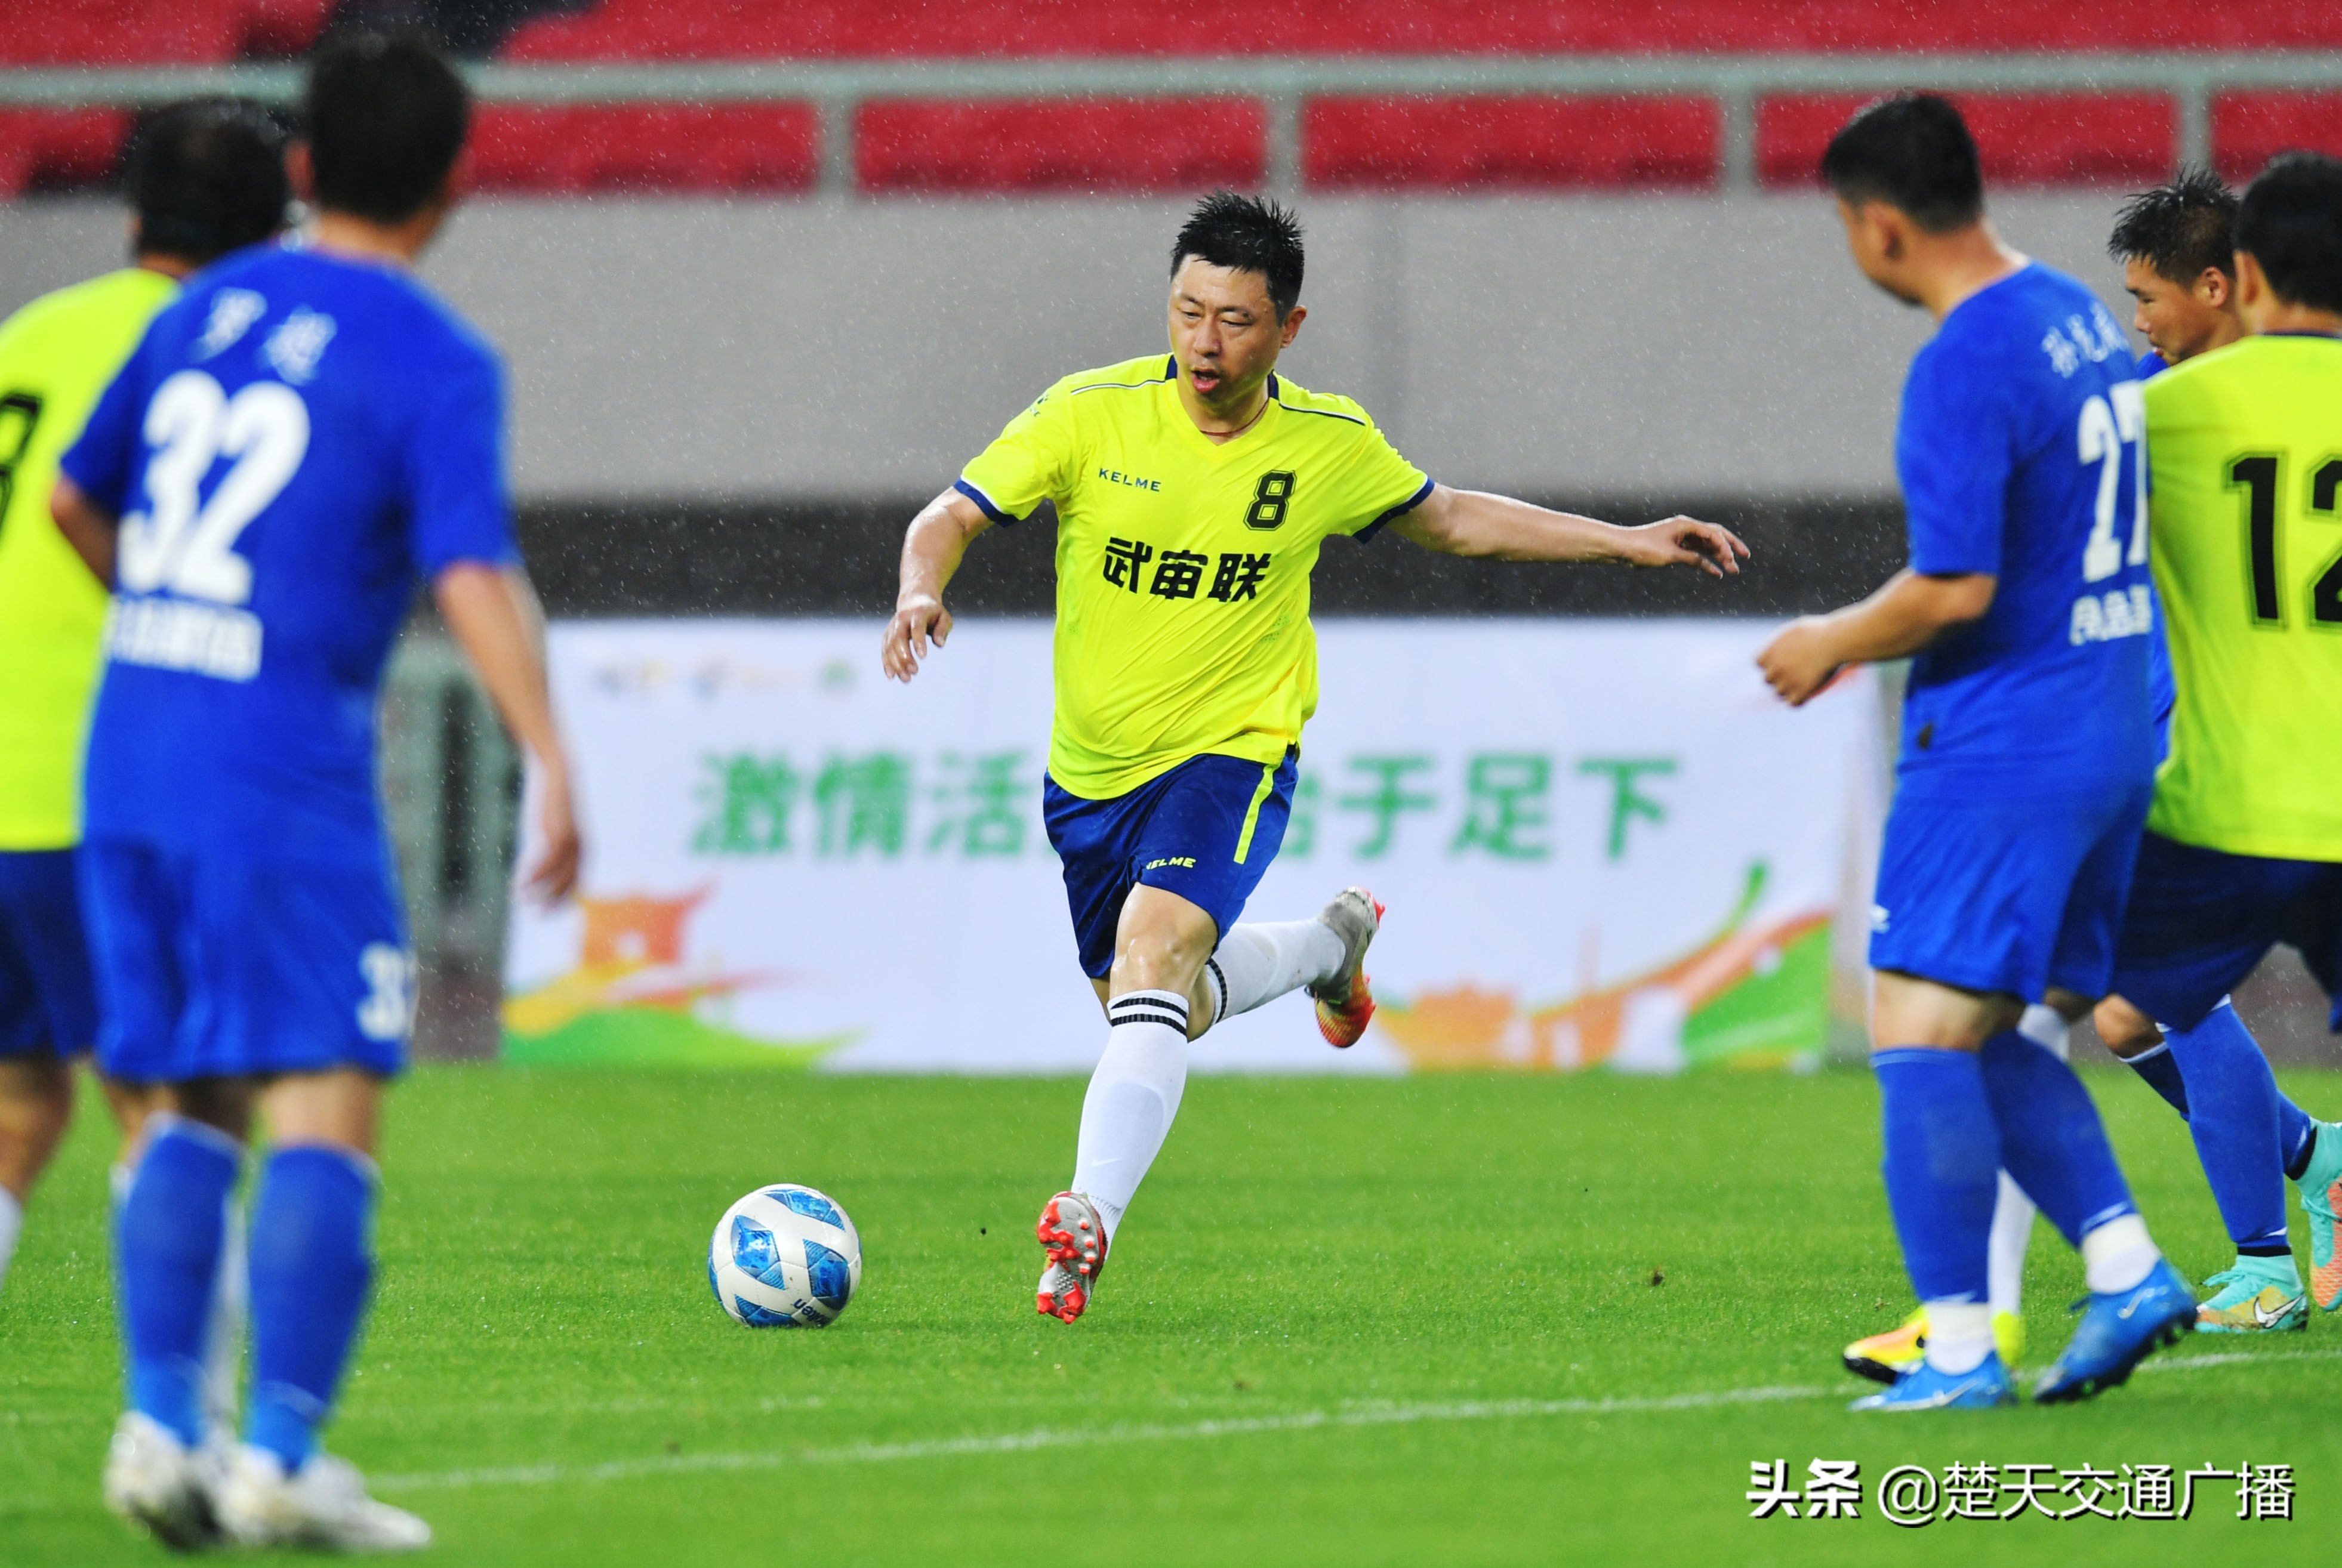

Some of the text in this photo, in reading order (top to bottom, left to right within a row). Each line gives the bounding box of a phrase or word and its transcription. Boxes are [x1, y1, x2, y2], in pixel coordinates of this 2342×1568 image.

[116, 368, 311, 607] 32
[1099, 467, 1161, 492] KELME
[1244, 469, 1297, 531] 8
[2078, 380, 2149, 583] 27
[1103, 536, 1272, 603] 武审联
[691, 750, 1054, 859] 激情活
